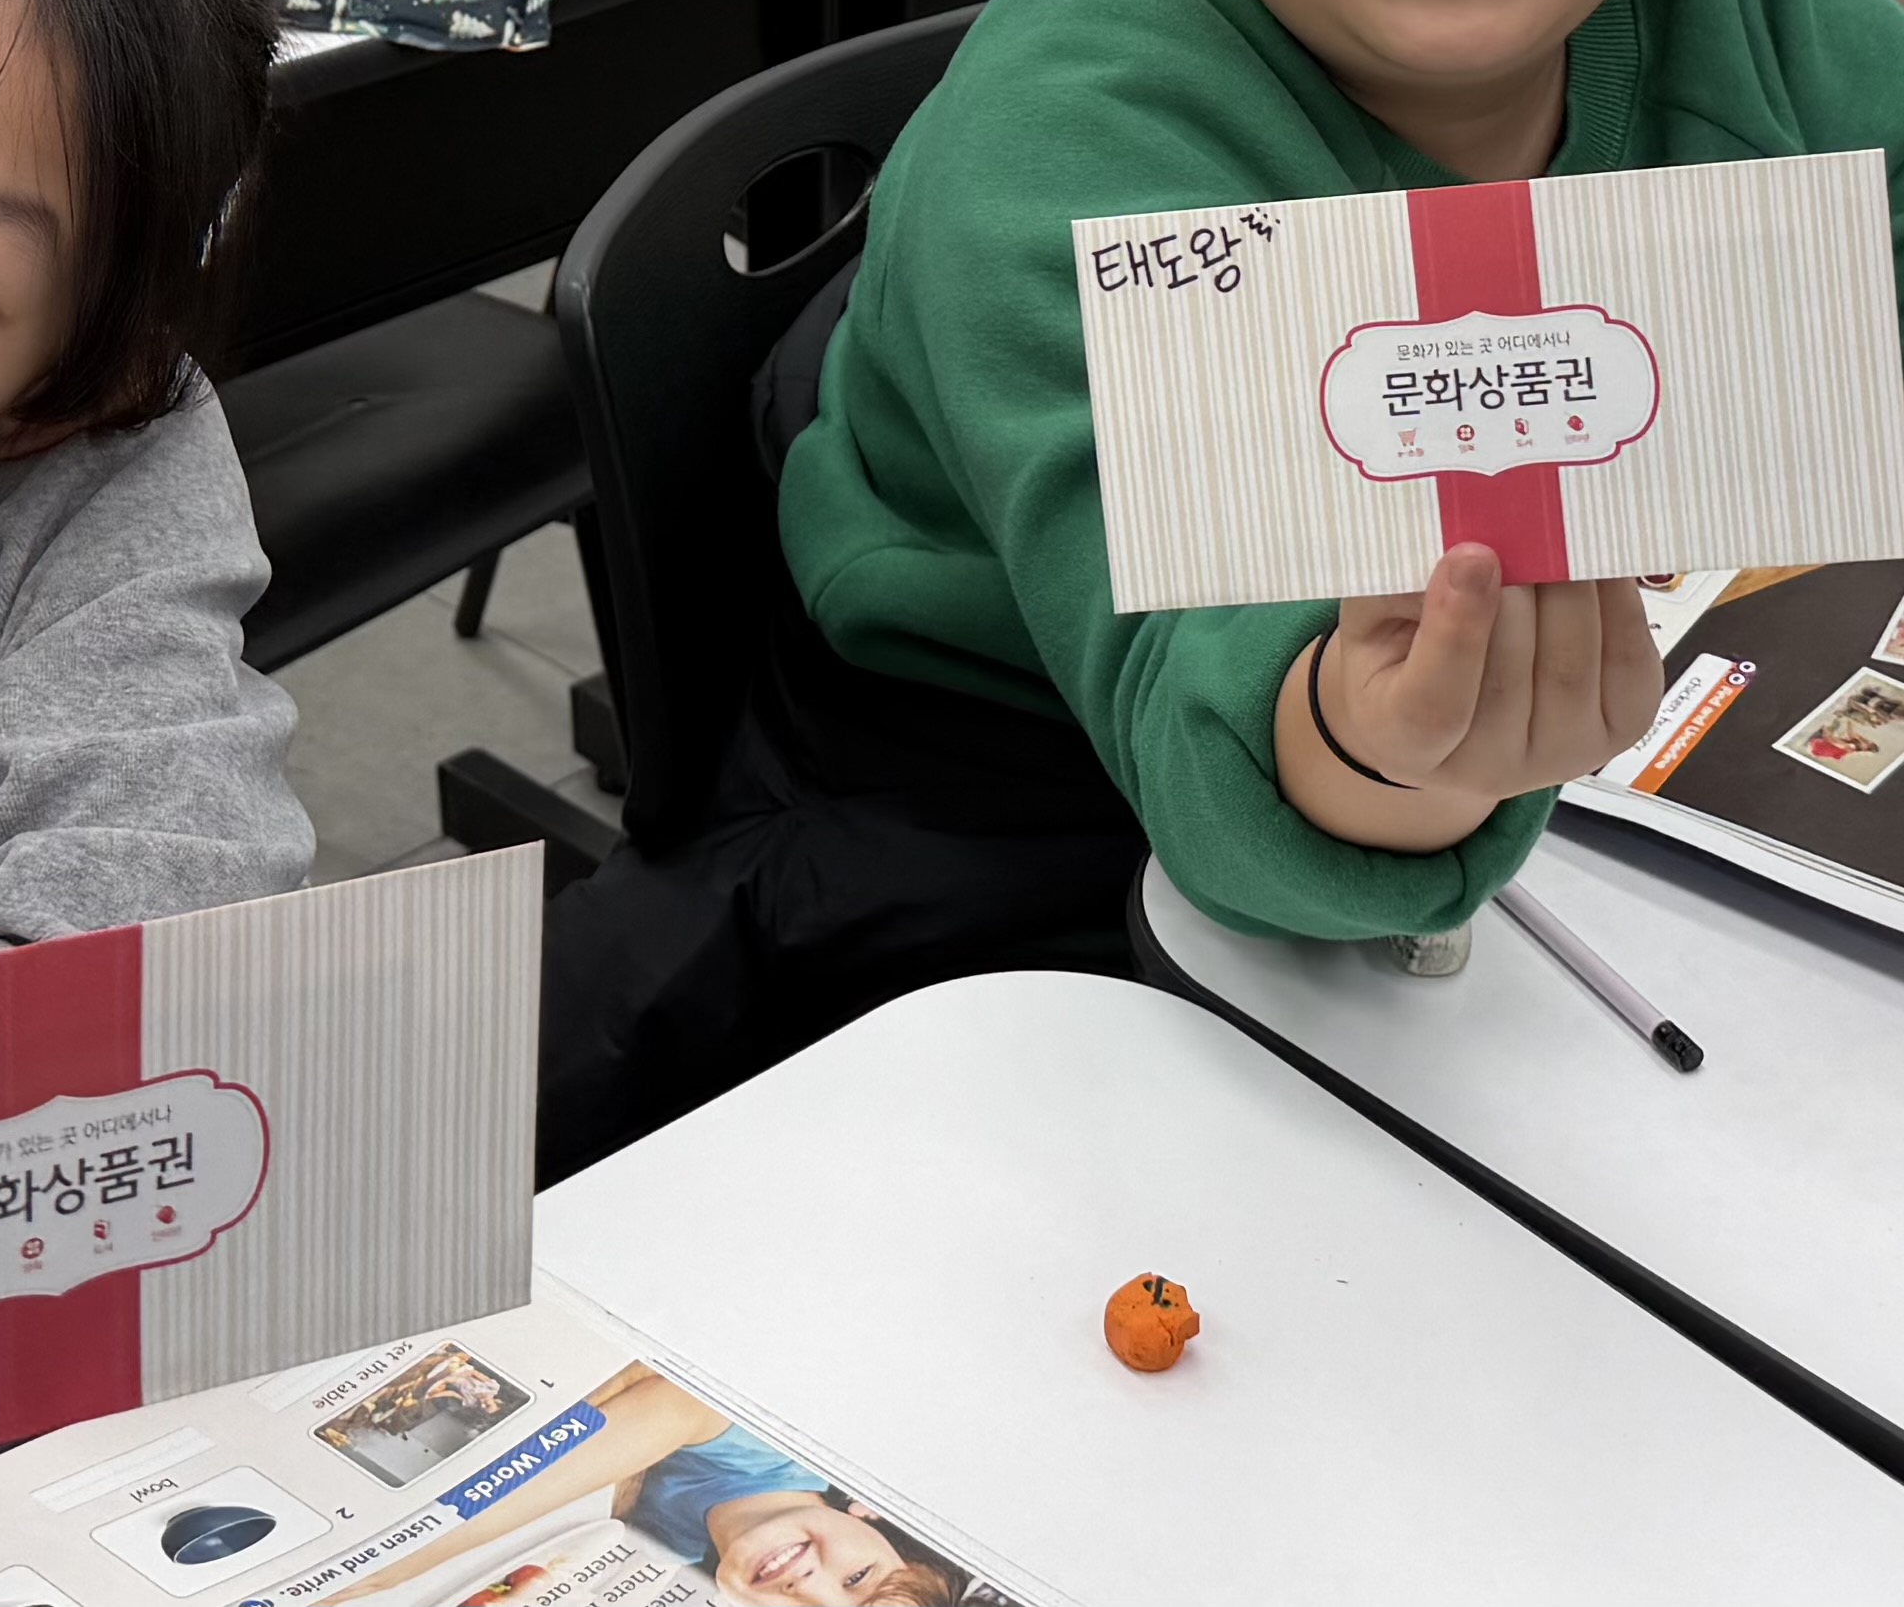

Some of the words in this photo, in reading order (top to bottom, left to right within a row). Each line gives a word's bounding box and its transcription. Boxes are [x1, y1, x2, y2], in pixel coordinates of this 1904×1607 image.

[1092, 226, 1243, 293] 태도왕
[1396, 342, 1440, 361] 문화가
[1445, 340, 1474, 357] 있는
[1479, 337, 1492, 354] 곳
[1497, 330, 1572, 351] 어디에서나
[1382, 356, 1597, 417] 문화상품권
[1708, 684, 1735, 708] Find
[17, 1135, 54, 1158] 있는
[59, 1125, 78, 1146] 곳
[82, 1104, 173, 1141] 어디에서나
[385, 1340, 415, 1364] set
[355, 1359, 390, 1382] the
[539, 1377, 556, 1390] 1
[311, 1380, 363, 1411] table
[537, 1417, 589, 1452] Key
[129, 1477, 180, 1504] bowl
[463, 1451, 543, 1503] Words
[335, 1506, 355, 1521] 2
[379, 1514, 444, 1552] Listen
[339, 1546, 382, 1575] and
[573, 1542, 639, 1585] There
[279, 1567, 343, 1599] write.
[535, 1580, 573, 1607] are
[603, 1562, 668, 1604] There
